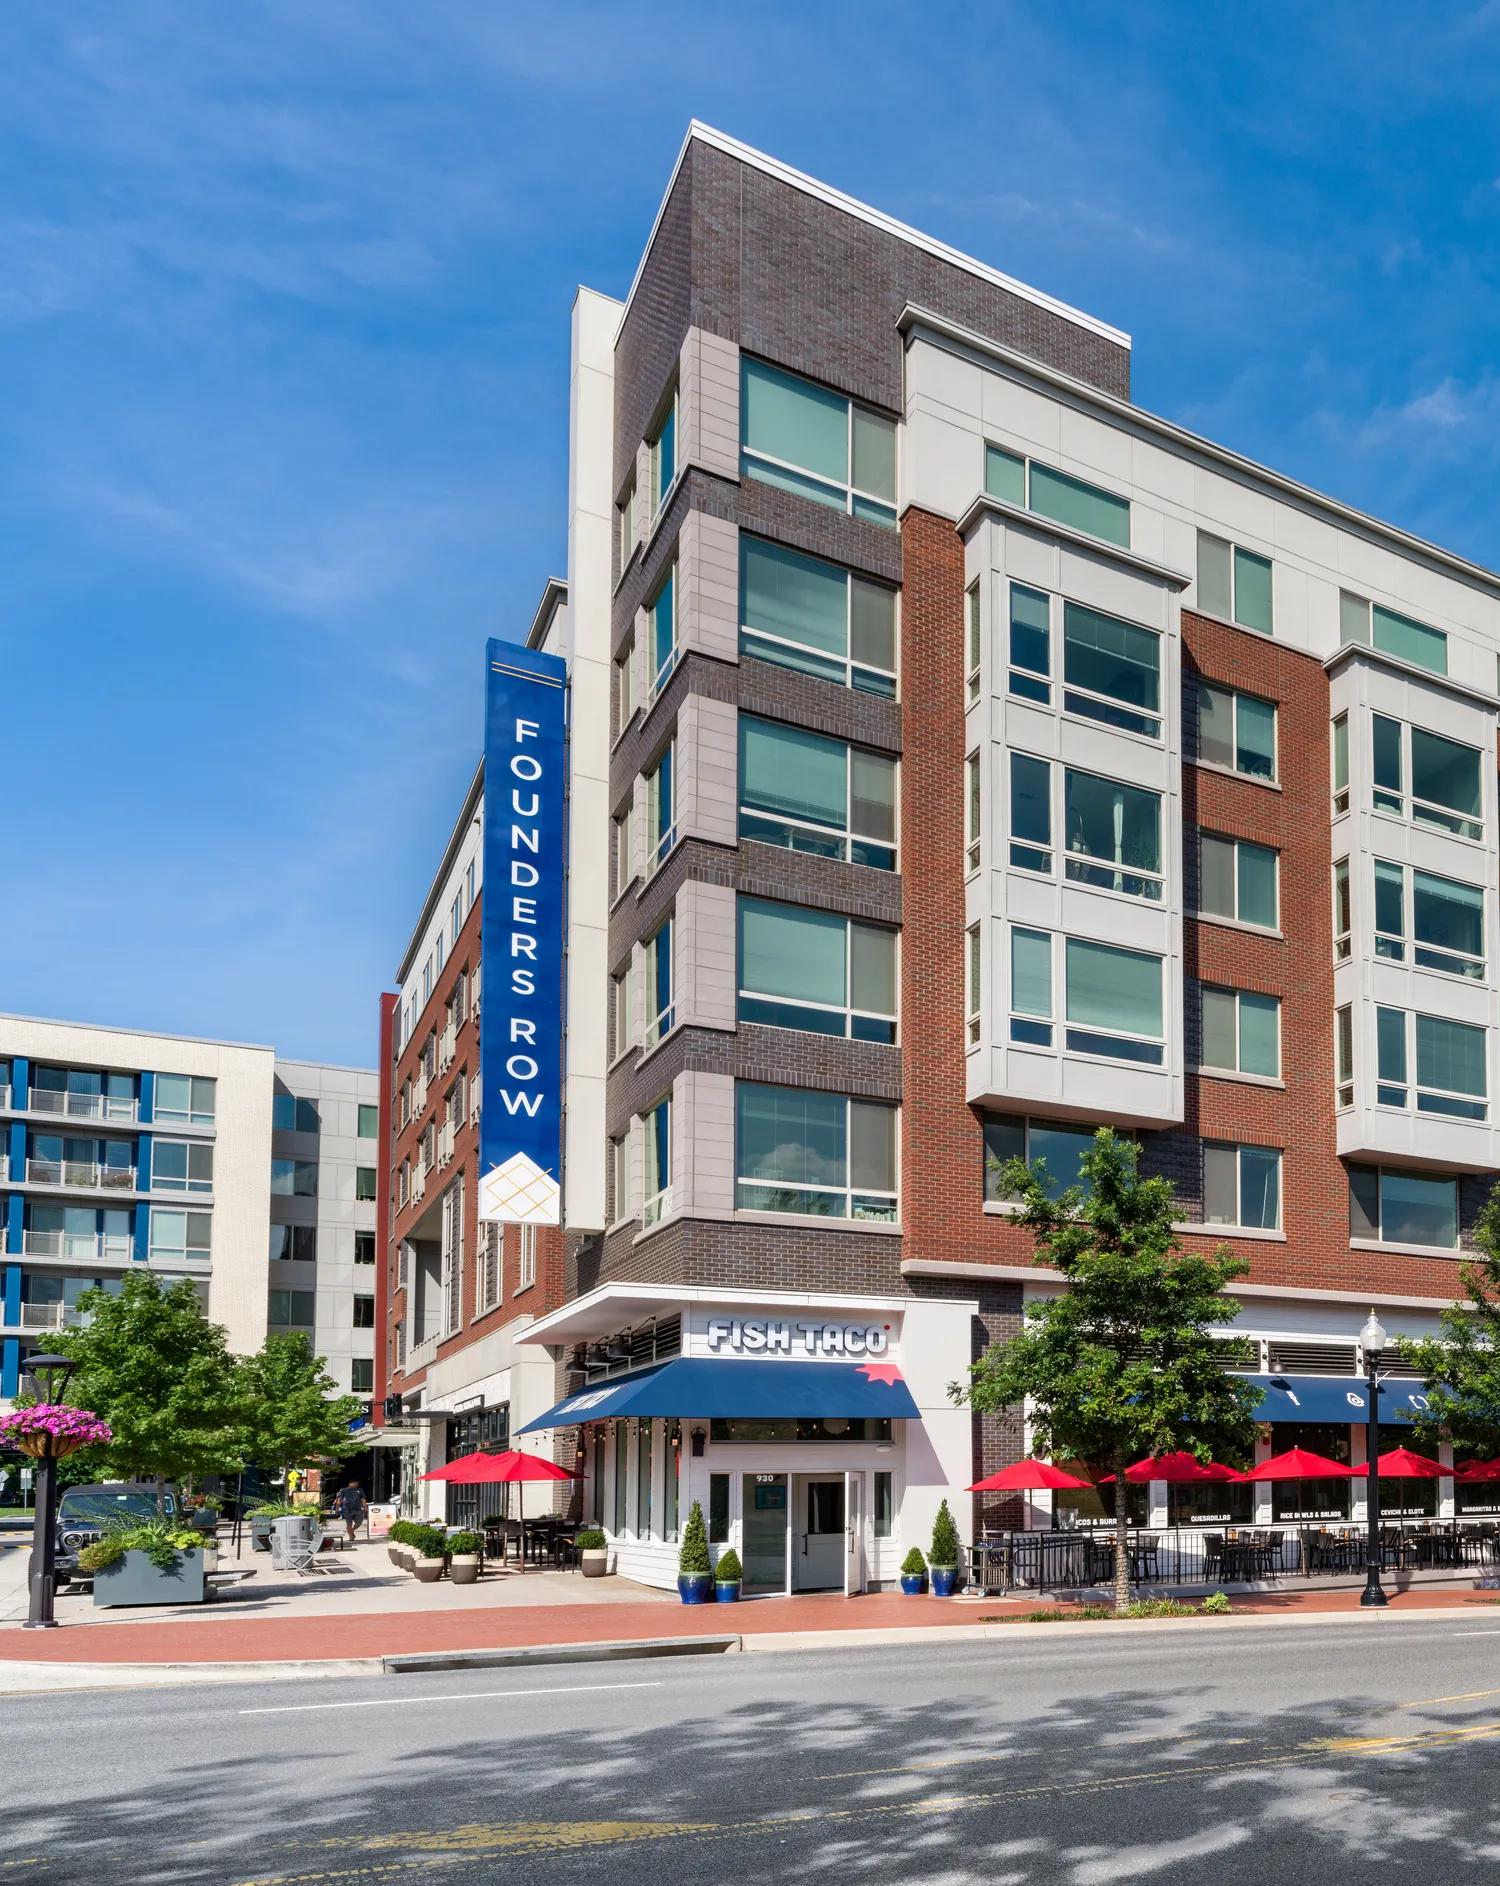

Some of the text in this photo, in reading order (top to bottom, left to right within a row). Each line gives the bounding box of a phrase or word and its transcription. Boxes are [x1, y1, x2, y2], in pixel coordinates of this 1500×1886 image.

[499, 717, 544, 1118] FOUNDERS ROW
[708, 1320, 887, 1353] FISH TACO
[756, 1474, 774, 1482] 930
[1461, 1505, 1492, 1513] MARGARITAS
[1190, 1514, 1231, 1523] QUESADILLAS
[1320, 1510, 1342, 1518] SALADS
[1100, 1516, 1133, 1526] BURRS
